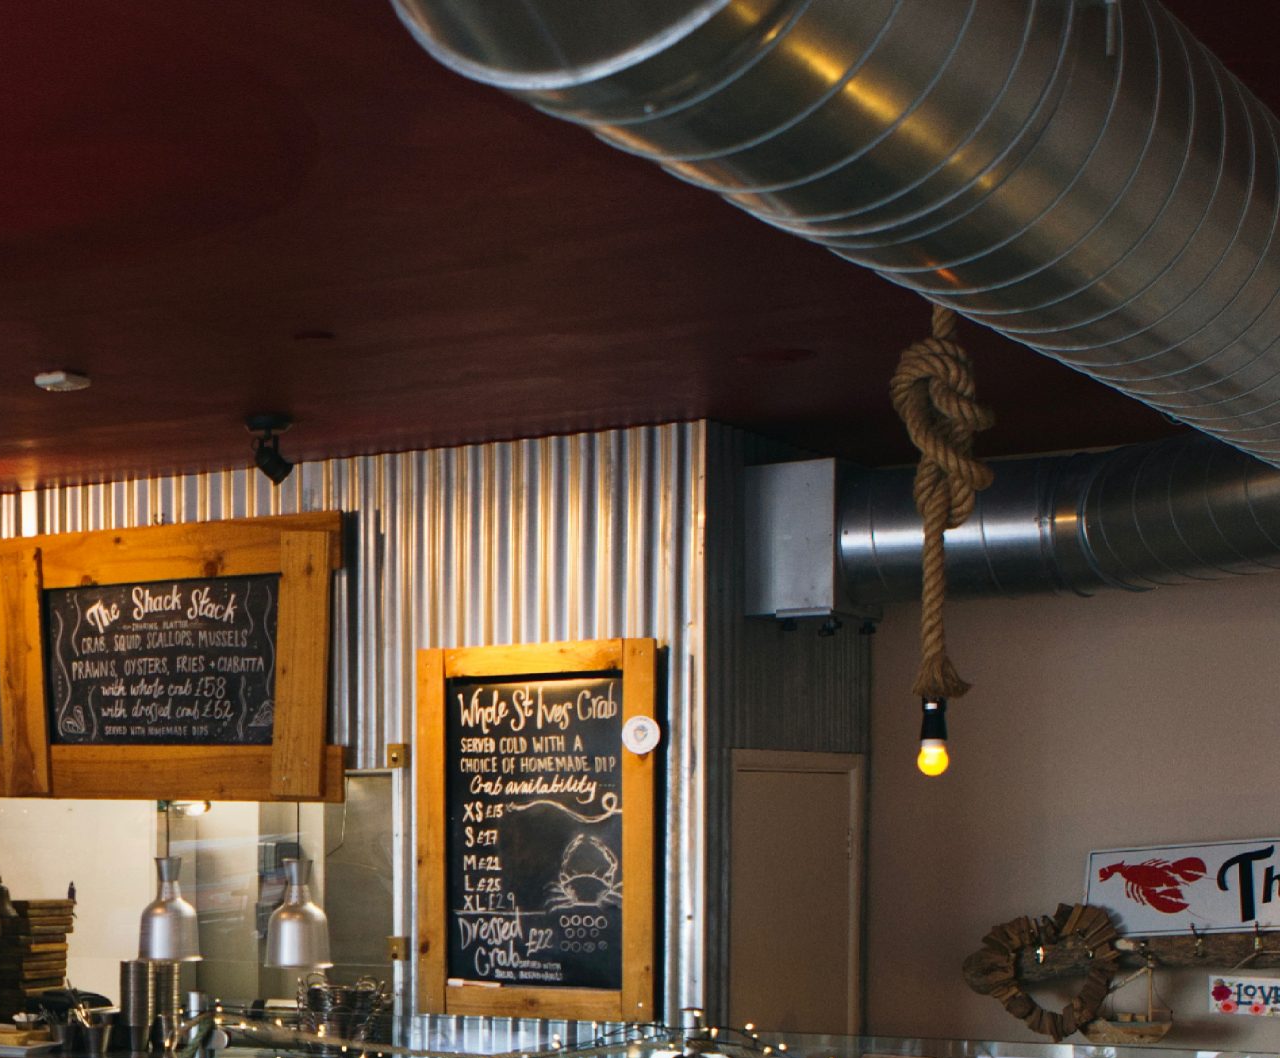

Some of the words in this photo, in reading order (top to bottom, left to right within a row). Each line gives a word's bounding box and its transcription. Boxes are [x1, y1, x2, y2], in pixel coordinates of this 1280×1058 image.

[86, 599, 120, 633] The
[132, 585, 182, 620] Shack
[187, 586, 237, 624] Stack
[198, 628, 248, 649] MUSSELS
[176, 655, 205, 674] FRIES
[217, 655, 265, 674] CIABATTA
[100, 680, 127, 697] with
[130, 678, 165, 698] whole
[167, 678, 192, 697] crab
[194, 676, 227, 700] £58
[100, 699, 127, 719] with
[175, 700, 200, 720] crab
[457, 688, 509, 735] Whole
[510, 685, 534, 732] St
[536, 686, 573, 730] Ives
[576, 682, 618, 721] Crab
[460, 737, 496, 754] SERVED
[499, 736, 528, 755] COLD
[532, 735, 565, 754] WITH
[573, 734, 584, 752] A
[460, 756, 498, 774] CHOICE
[502, 756, 515, 775] OF
[519, 756, 591, 774] HOMEMADE
[594, 755, 617, 774] DIP
[470, 775, 503, 796] Crab
[505, 774, 598, 805] availability
[462, 801, 483, 823] XS
[464, 825, 475, 848] S
[463, 854, 477, 871] M
[464, 874, 475, 892] L
[1217, 845, 1280, 922] Th
[463, 893, 487, 911] XL
[458, 906, 524, 951] Dressed
[474, 940, 520, 977] Crab
